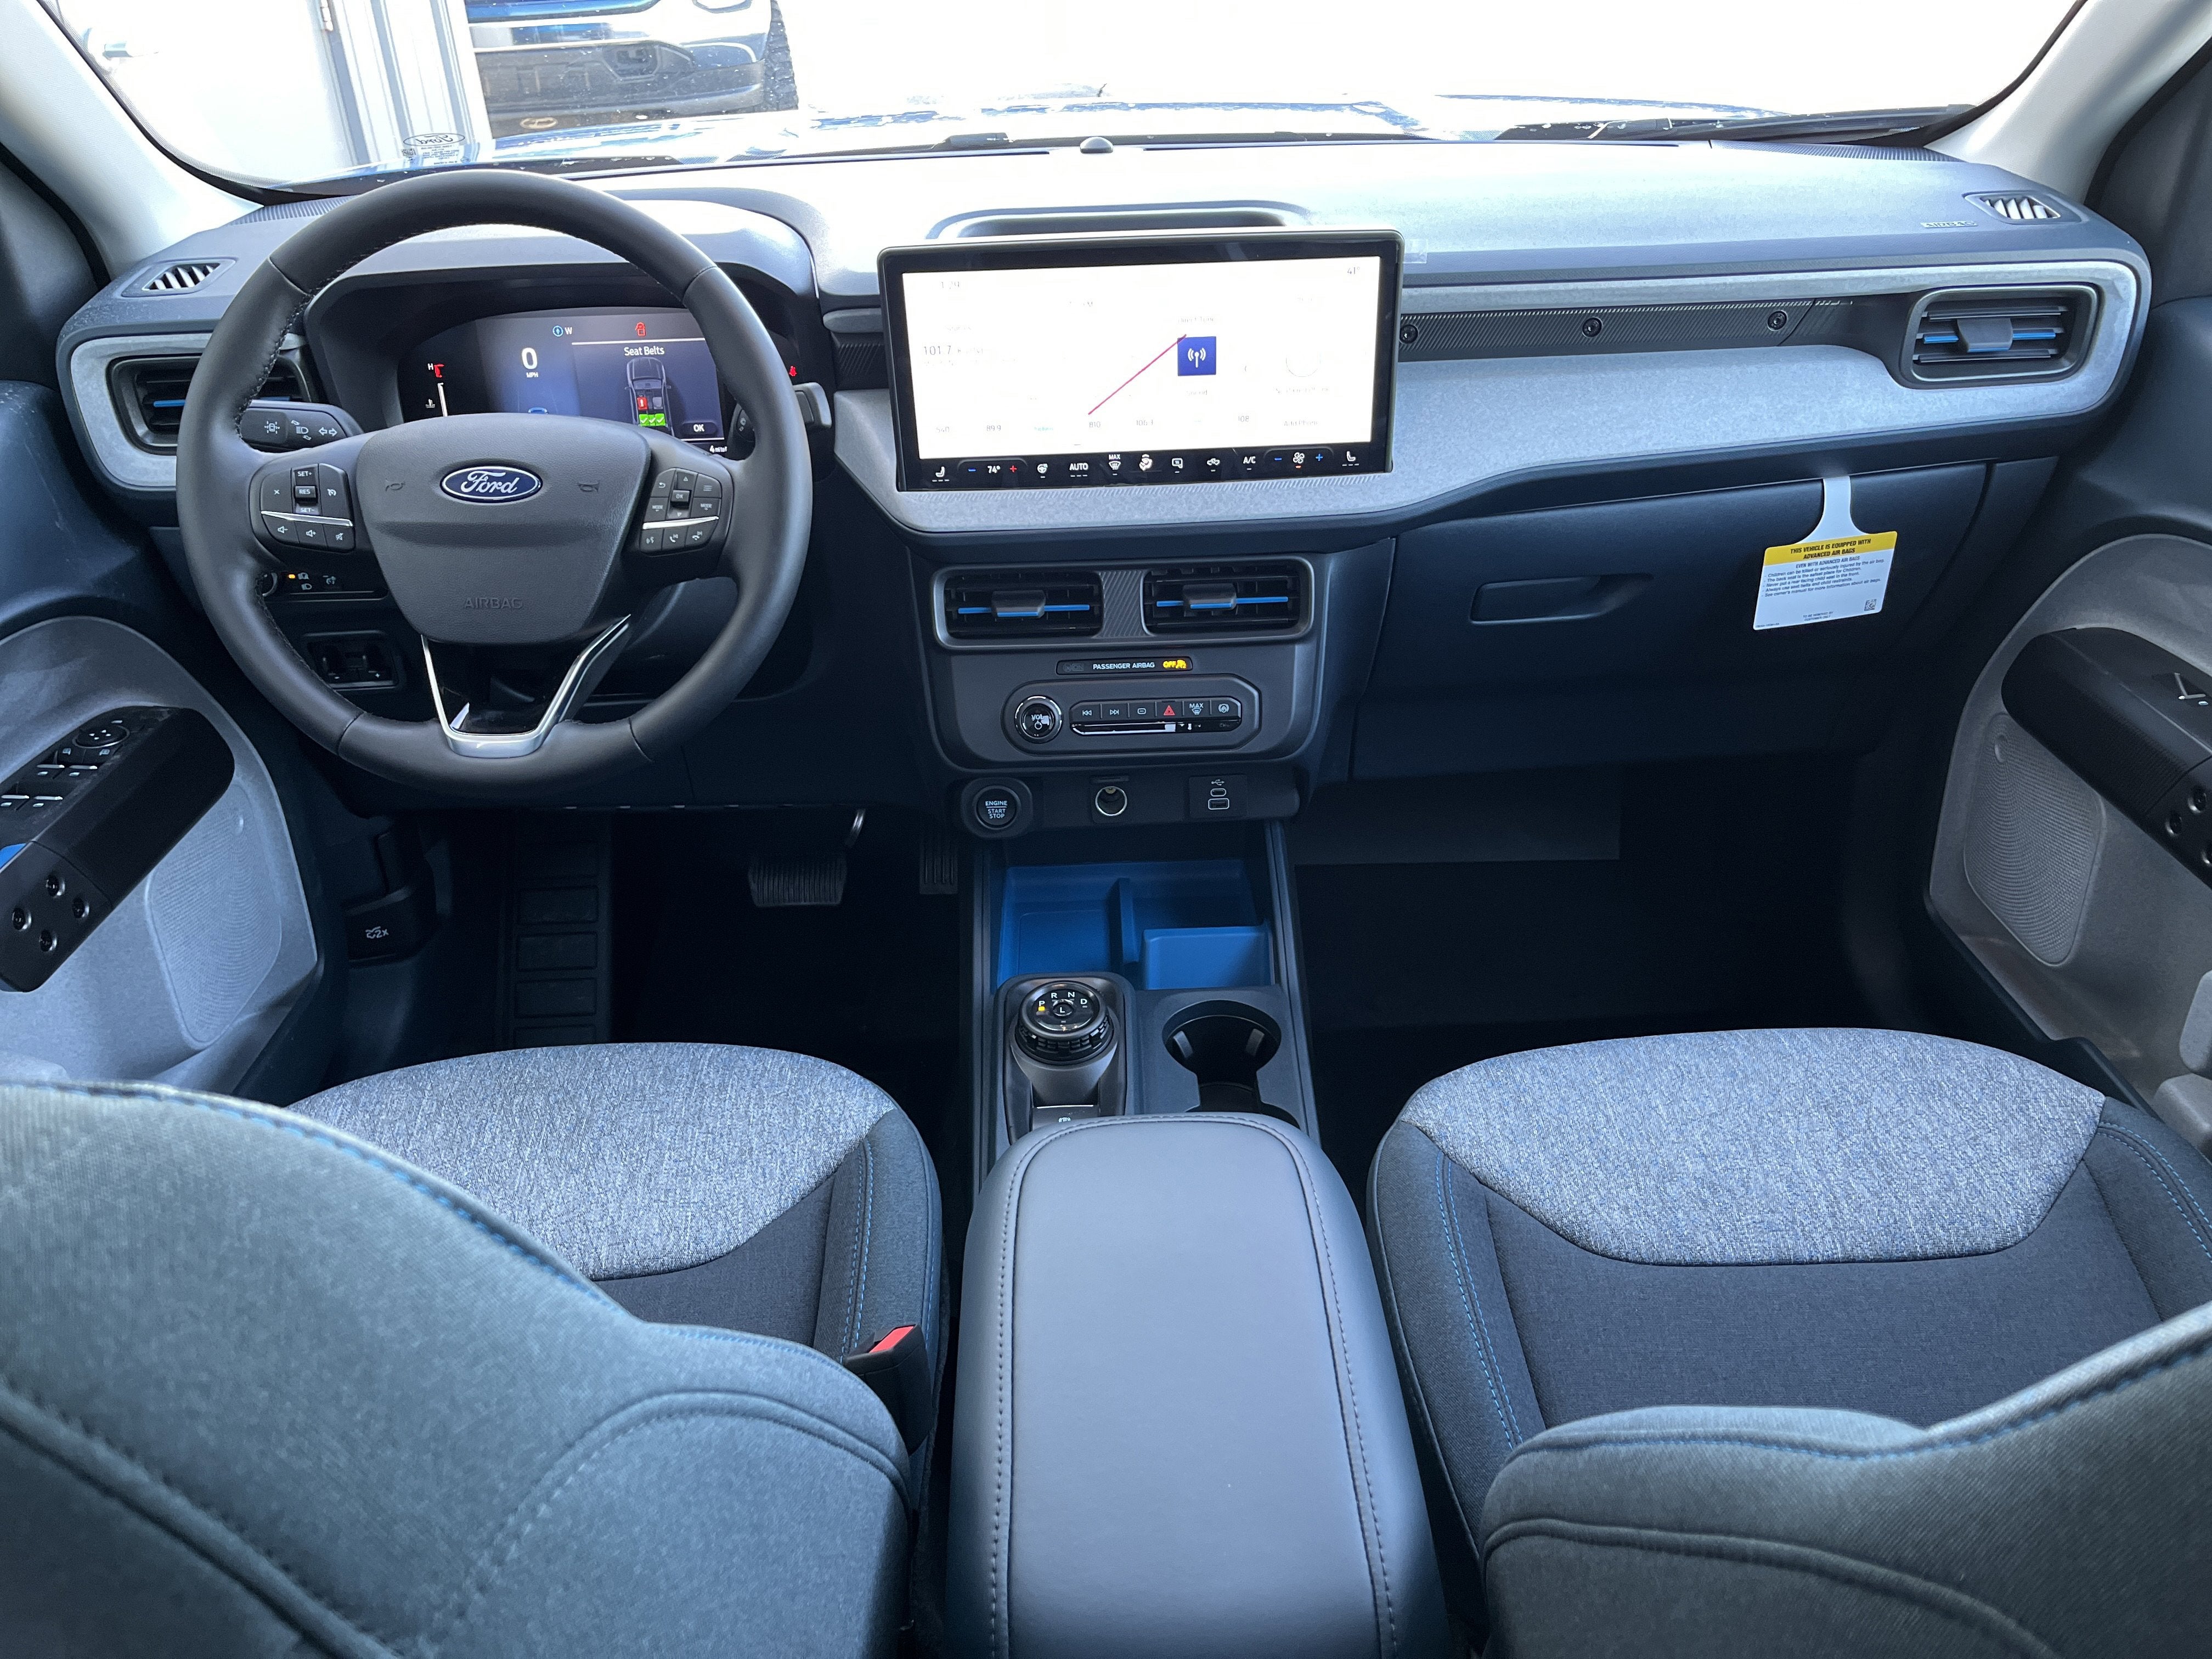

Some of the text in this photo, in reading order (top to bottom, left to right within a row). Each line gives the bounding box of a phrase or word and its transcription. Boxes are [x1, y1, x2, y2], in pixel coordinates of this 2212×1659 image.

[564, 326, 573, 335] W
[624, 345, 665, 357] Seat Belts
[522, 347, 538, 370] 0
[693, 424, 705, 432] OK
[1243, 456, 1256, 464] A/C
[988, 465, 1001, 473] 74°
[1069, 462, 1089, 471] AUTO
[460, 470, 520, 494] Ford
[1803, 544, 1825, 552] VEHICLE
[1832, 540, 1857, 549] EQUIPPED
[1803, 551, 1831, 560] ADVANCED
[464, 597, 523, 609] AIRBAG
